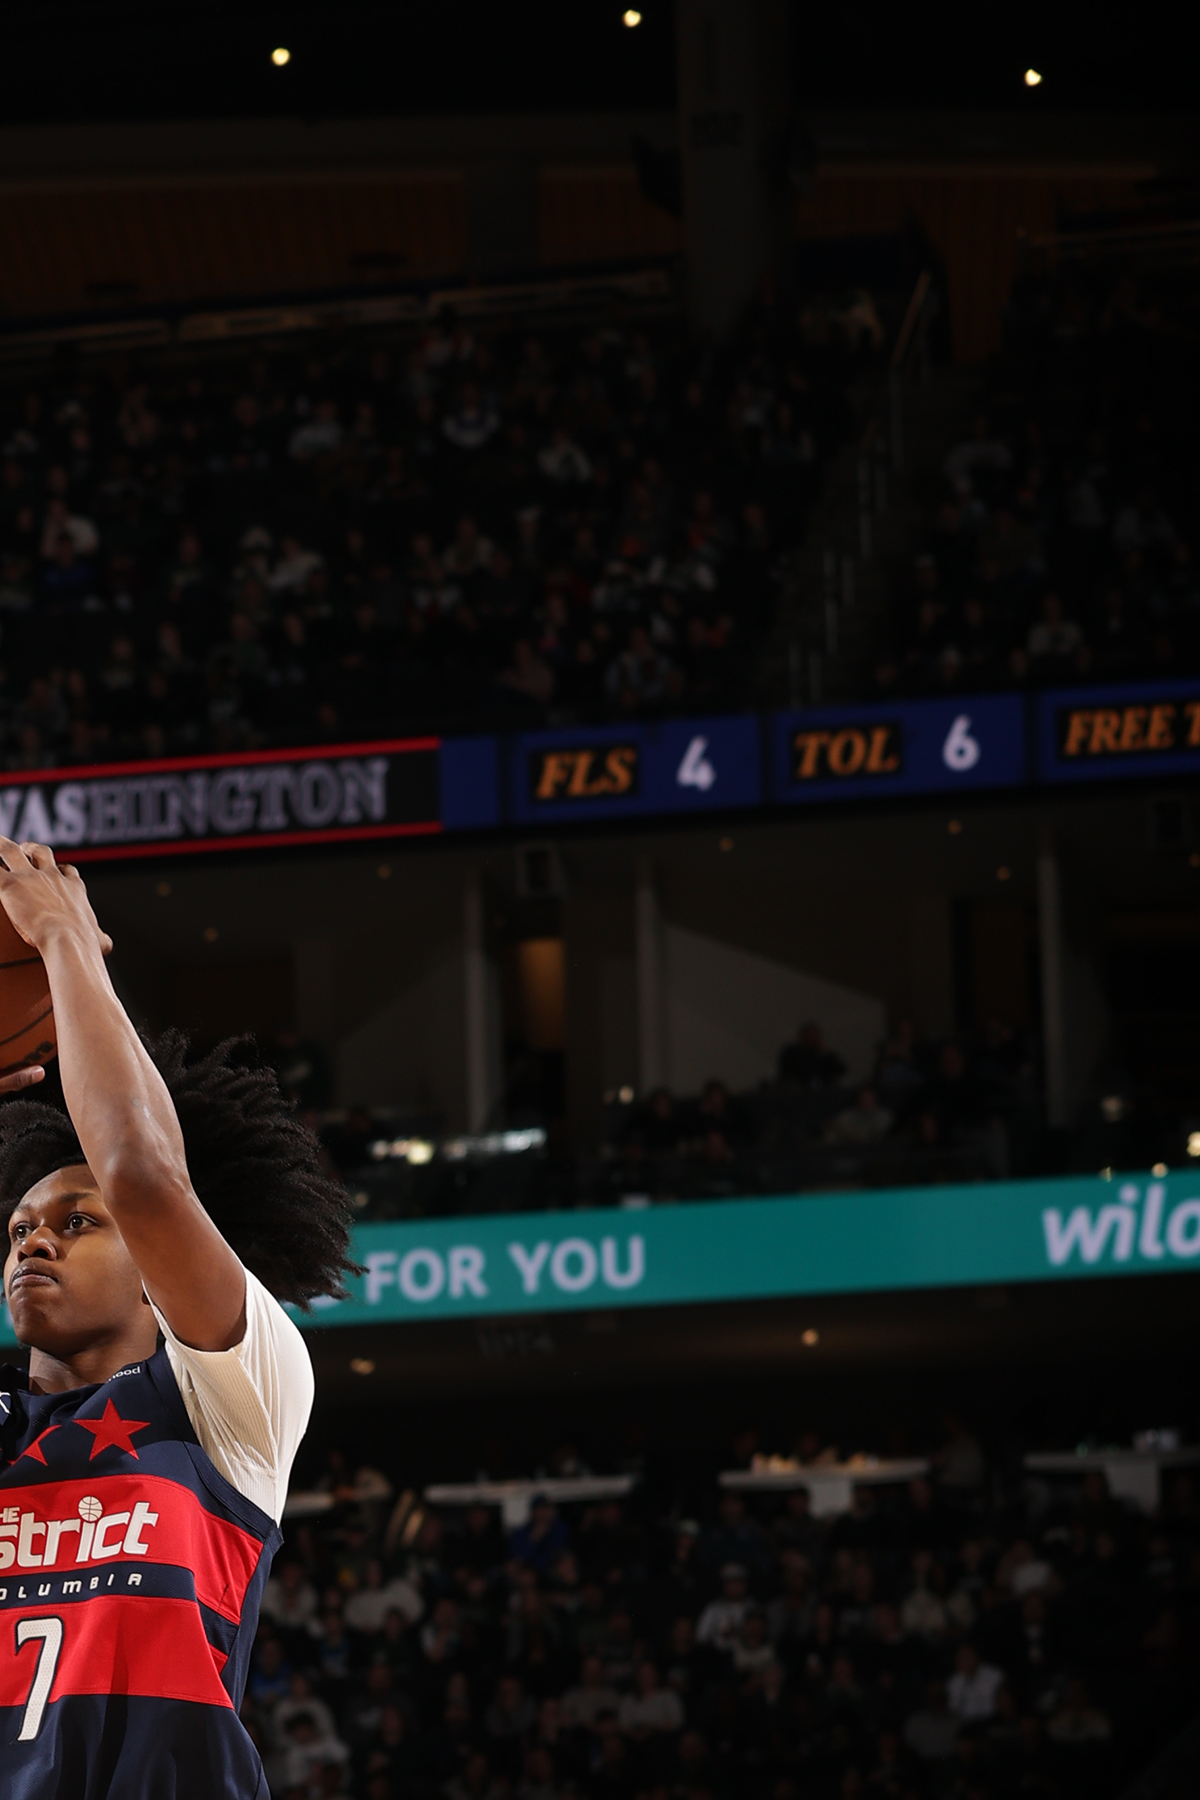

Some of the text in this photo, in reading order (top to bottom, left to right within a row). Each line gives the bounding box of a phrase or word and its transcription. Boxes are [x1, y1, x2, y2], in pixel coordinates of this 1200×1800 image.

[794, 715, 980, 779] TOL 6
[1064, 704, 1175, 756] FREE
[536, 735, 715, 798] FLS 4
[1043, 1183, 1200, 1265] wilo
[364, 1235, 645, 1303] FOR YOU
[14, 1615, 64, 1743] 7
